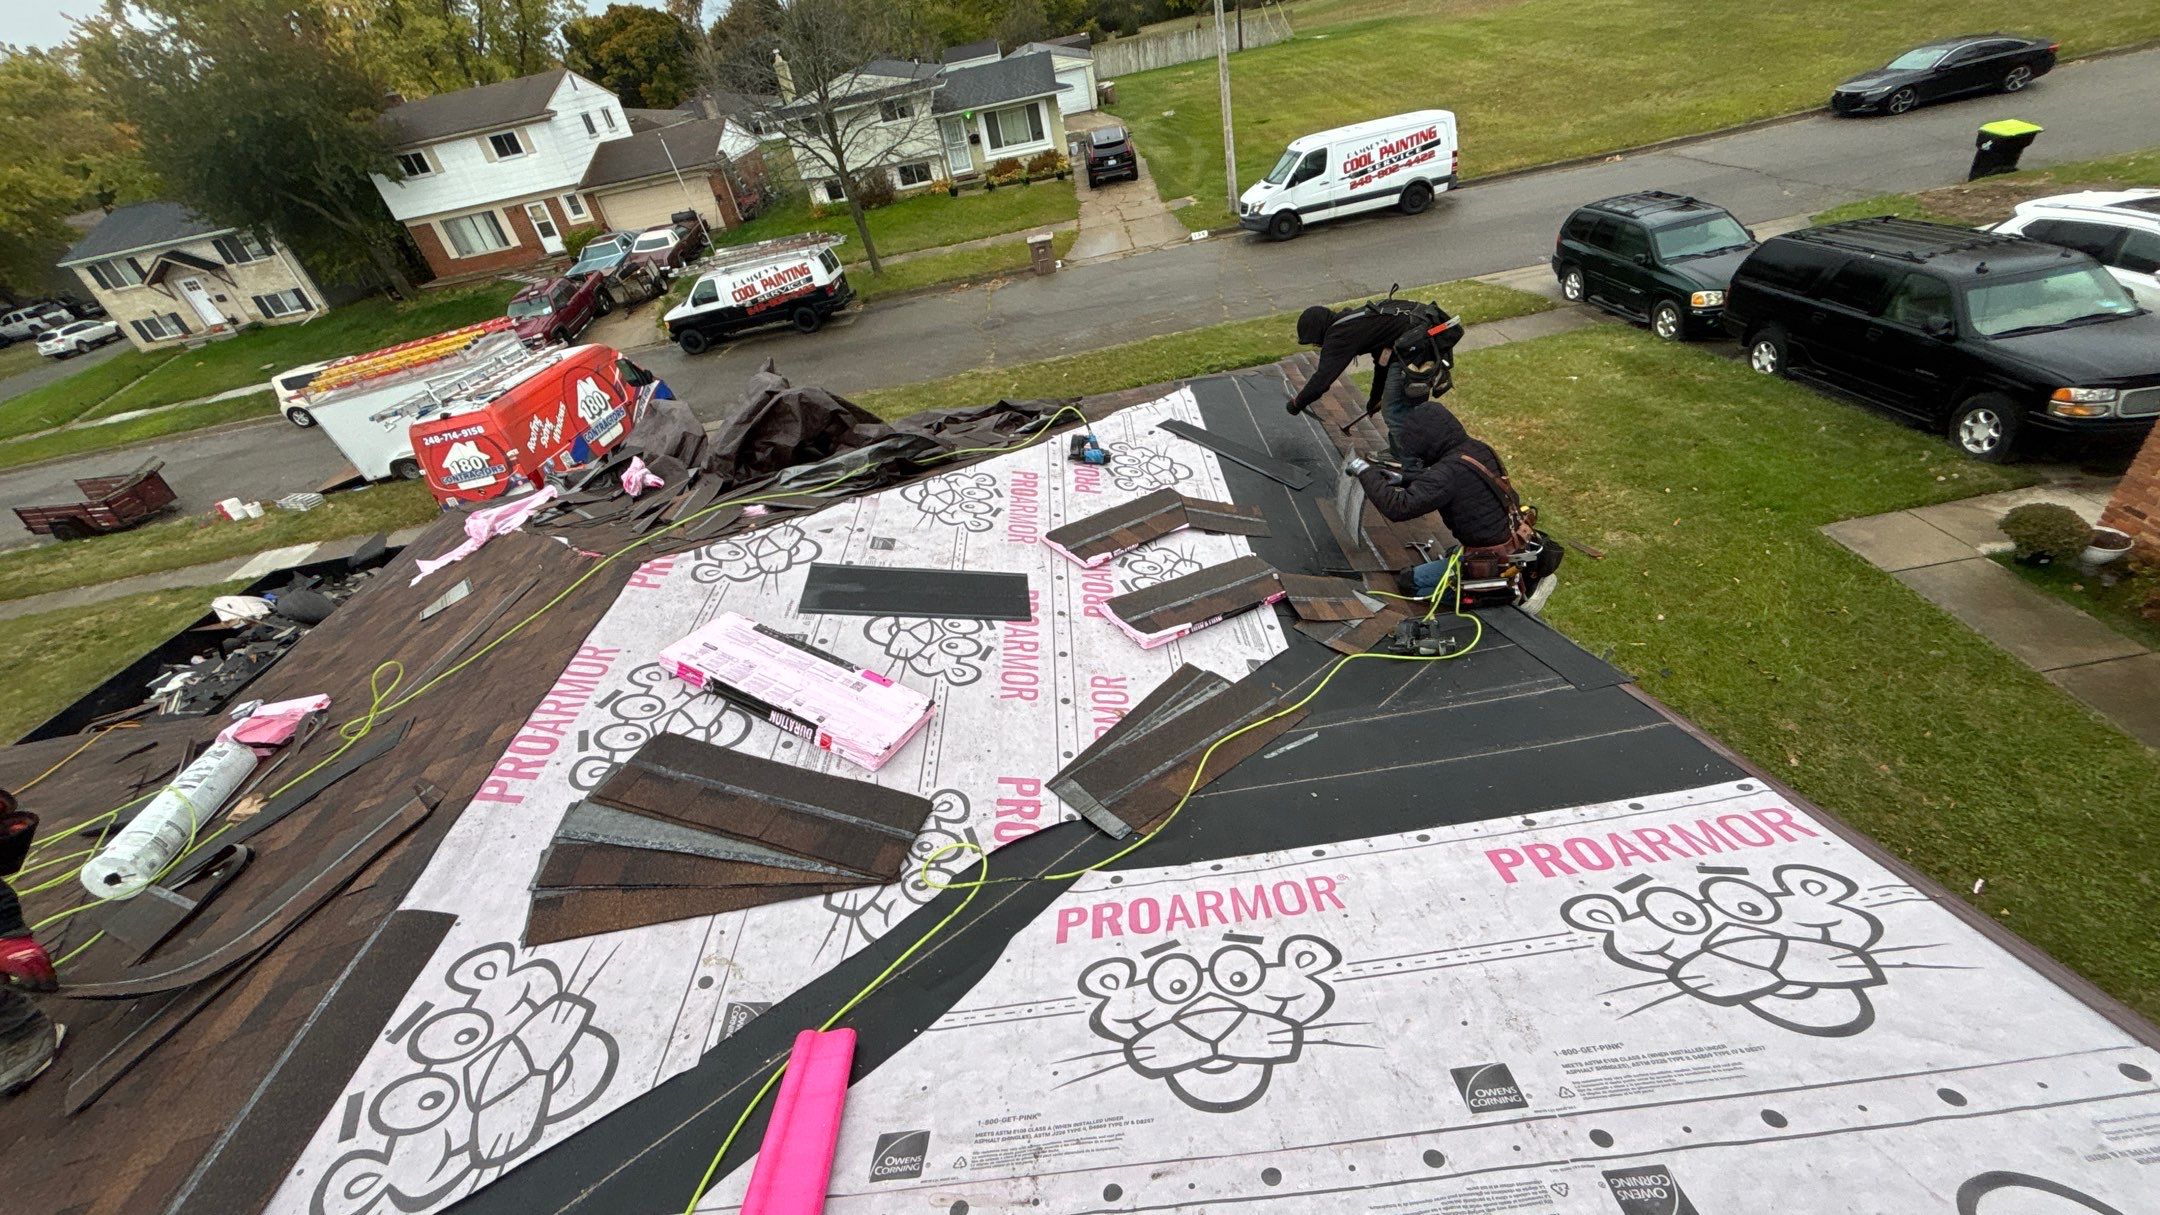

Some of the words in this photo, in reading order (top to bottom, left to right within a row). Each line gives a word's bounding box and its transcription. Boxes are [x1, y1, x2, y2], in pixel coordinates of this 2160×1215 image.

[1343, 152, 1375, 174] COOL
[1379, 125, 1437, 159] PAINTING
[1367, 146, 1422, 173] SERVICE
[731, 283, 760, 303] COOL
[760, 262, 811, 291] PAINTING
[757, 279, 807, 302] SERVICE
[580, 391, 607, 419] 180
[423, 425, 485, 446] 248-714-9158
[527, 414, 543, 453] Roofing
[553, 401, 566, 444] Windows
[583, 406, 626, 444] CONTRACTORS
[442, 465, 506, 484] CONTRACTORS
[450, 456, 485, 475] 180
[1008, 471, 1038, 544] PROARMOR
[474, 645, 621, 804] PROARMOR
[769, 710, 813, 741] DURATION
[1484, 807, 1819, 884] PROARMOR
[1055, 875, 1346, 944] PROARMOR
[1470, 1095, 1522, 1107] CORNING
[1475, 1086, 1517, 1097] OWENS
[874, 1162, 920, 1175] CORNING
[885, 1155, 922, 1166] OWENS
[1610, 1174, 1671, 1188] CORNING
[1617, 1187, 1668, 1200] OWENS
